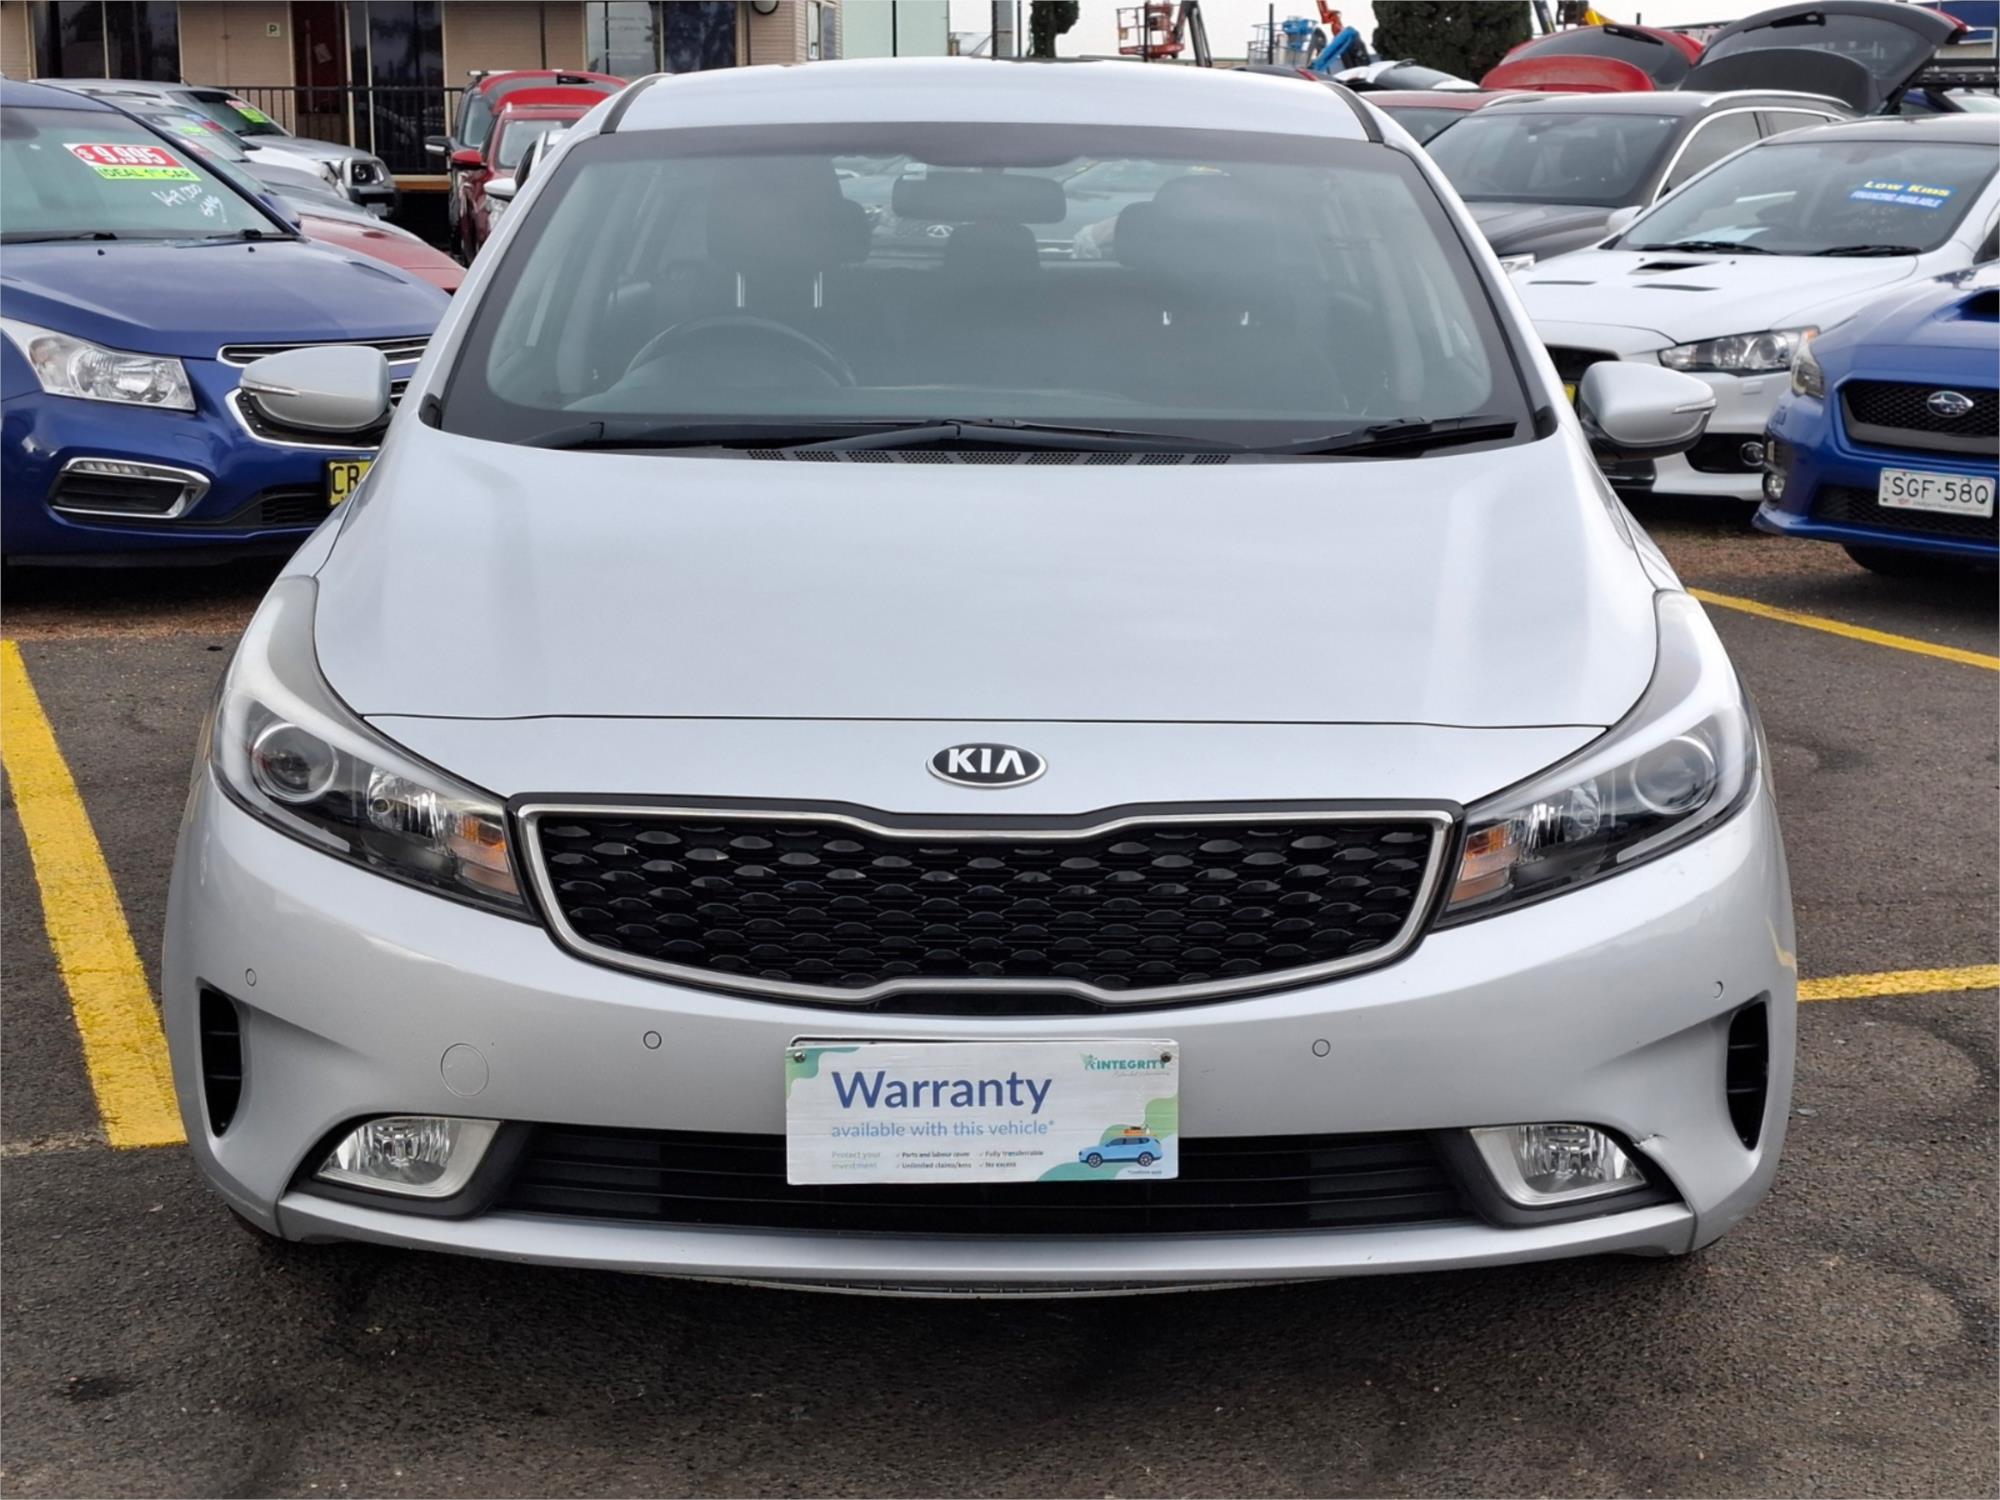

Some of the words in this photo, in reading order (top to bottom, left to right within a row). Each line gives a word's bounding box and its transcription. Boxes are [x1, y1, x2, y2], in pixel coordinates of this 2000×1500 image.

[1864, 181, 1904, 190] Low
[948, 748, 1026, 776] KIA
[1096, 1059, 1166, 1070] INTEGRITY
[831, 1070, 1053, 1115] Warranty
[831, 1123, 905, 1138] available
[910, 1122, 948, 1137] with
[953, 1121, 984, 1136] this
